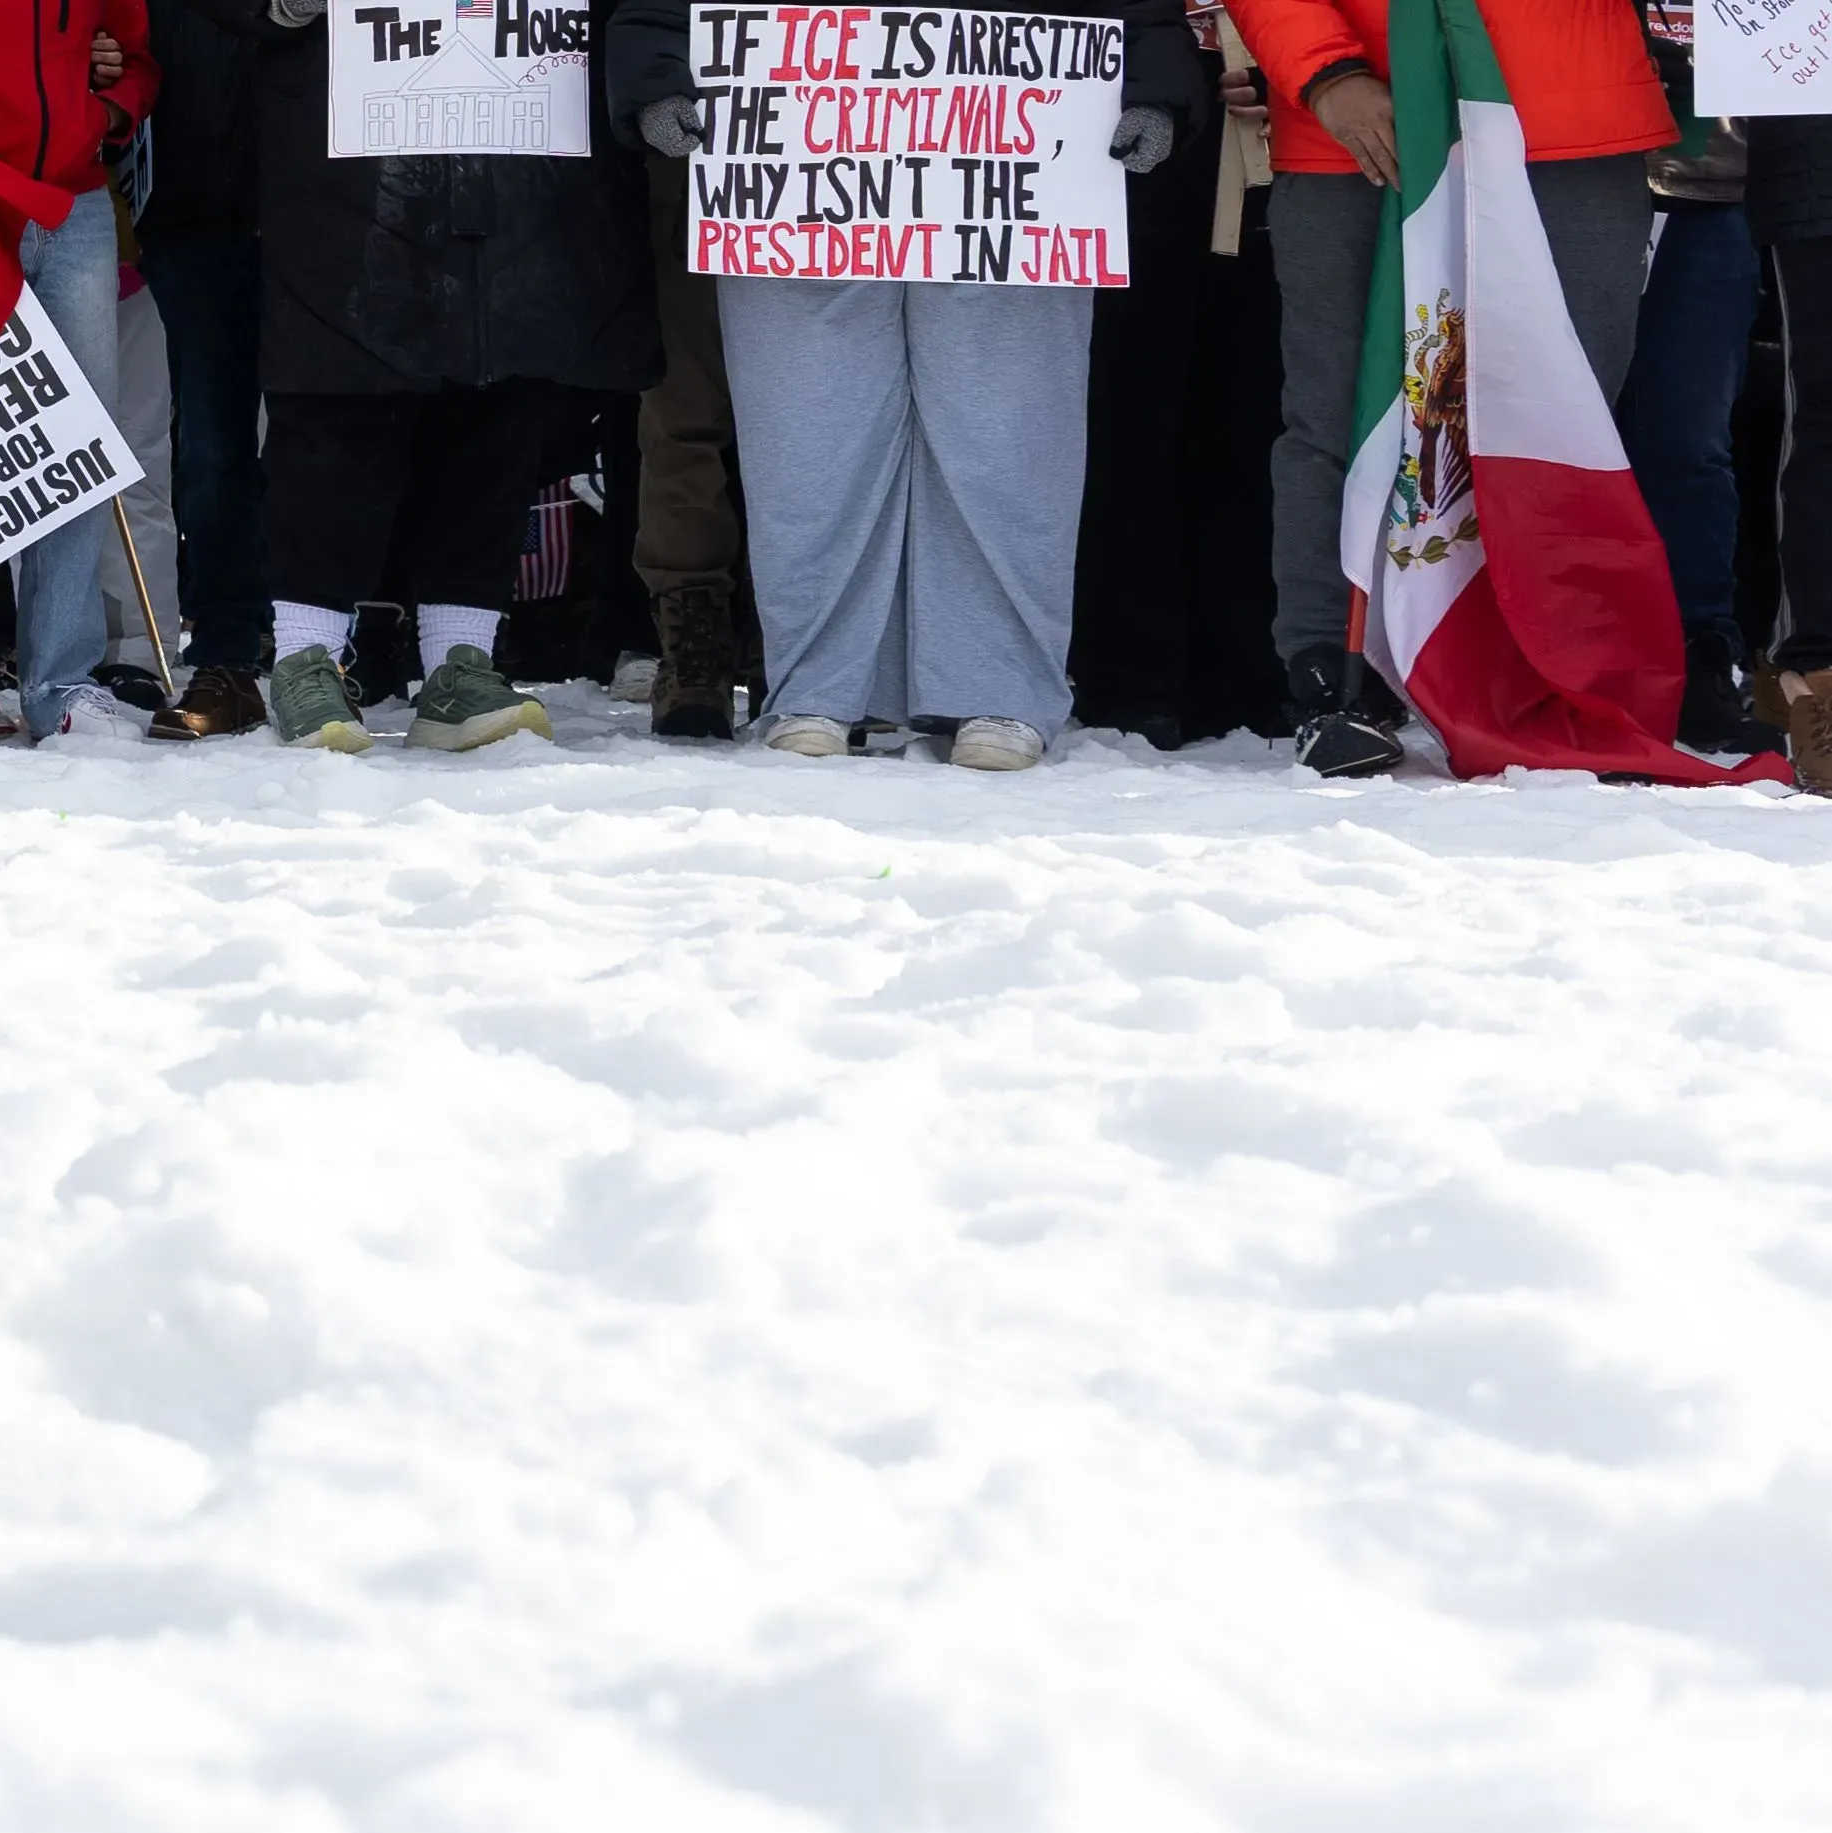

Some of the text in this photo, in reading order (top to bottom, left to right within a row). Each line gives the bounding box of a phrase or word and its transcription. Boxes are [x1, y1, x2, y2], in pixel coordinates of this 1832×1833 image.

[355, 6, 442, 62] THE
[700, 7, 1122, 82] IF ICE IS ARRESTING
[1761, 42, 1801, 73] Ice
[698, 84, 787, 156] THE
[696, 154, 1040, 225] WHY ISN'T THE
[697, 219, 1128, 287] PRESIDENT IN JAIL
